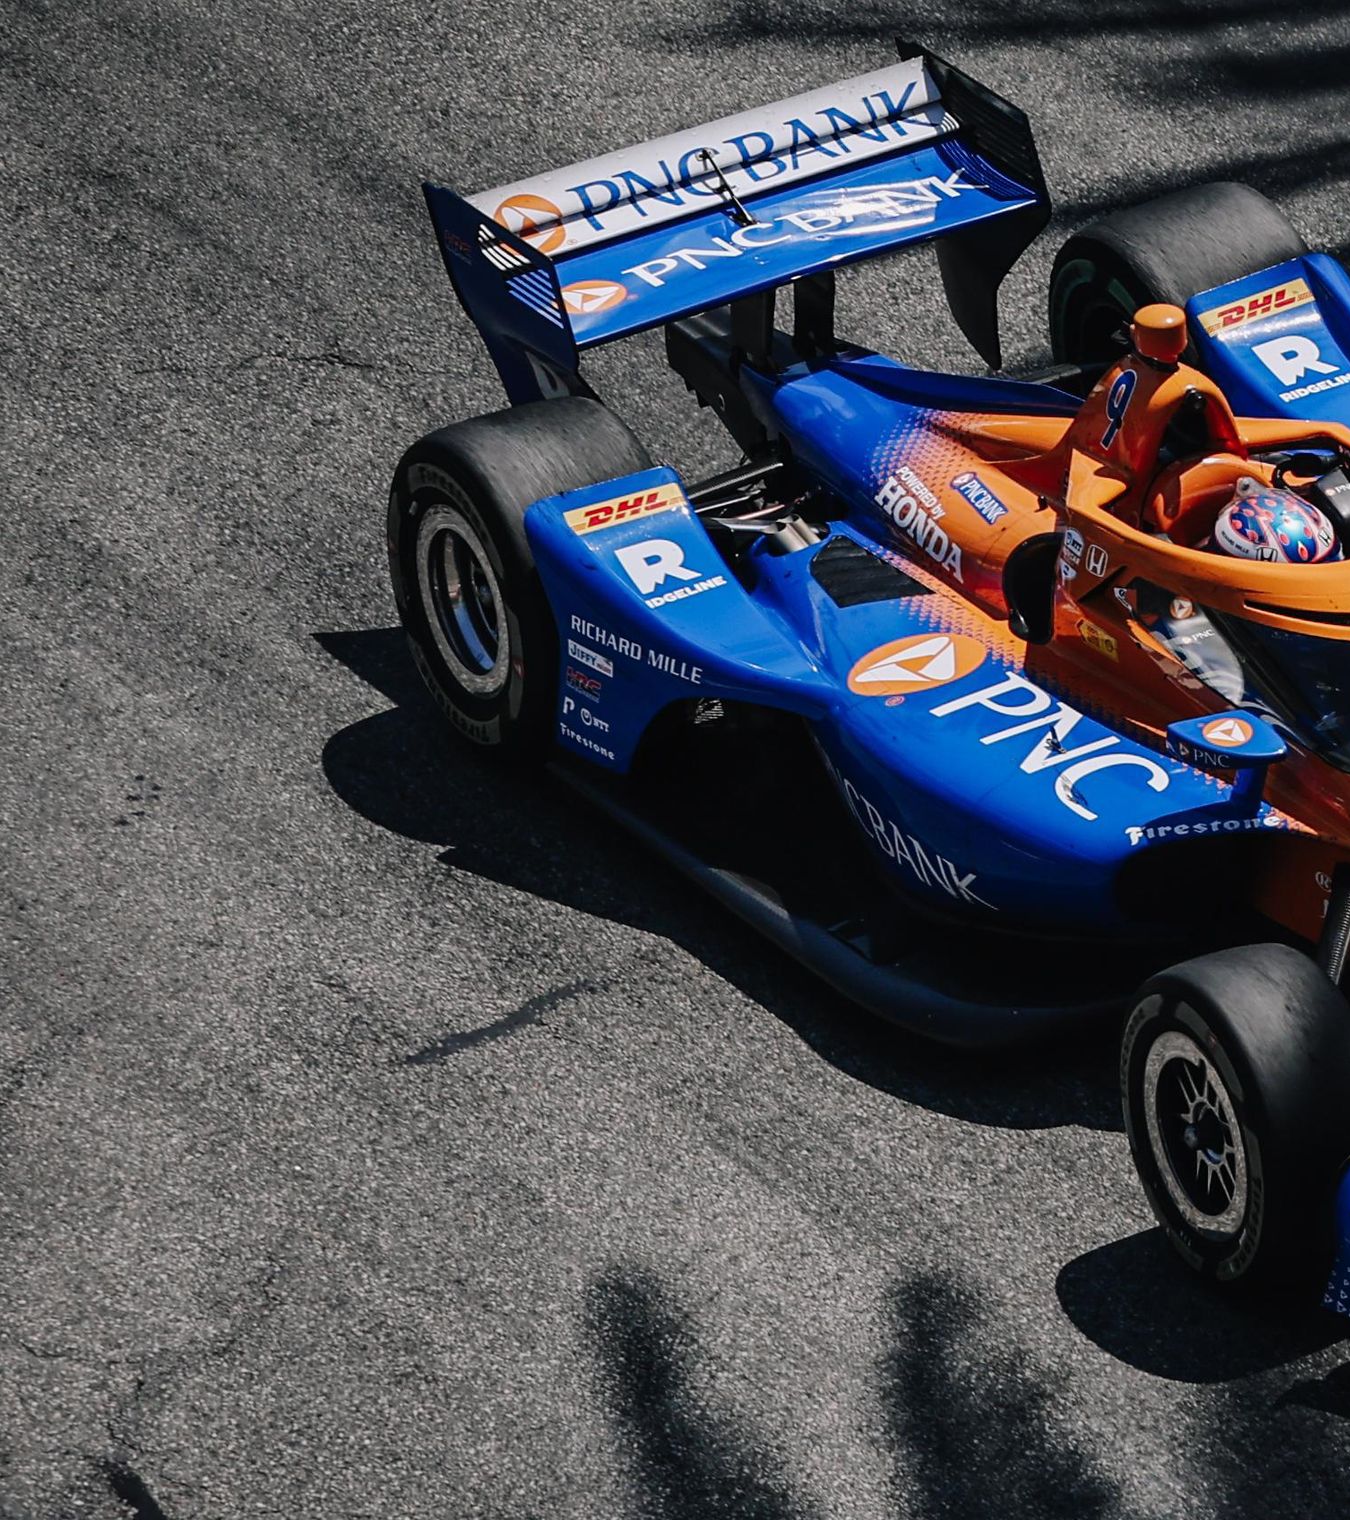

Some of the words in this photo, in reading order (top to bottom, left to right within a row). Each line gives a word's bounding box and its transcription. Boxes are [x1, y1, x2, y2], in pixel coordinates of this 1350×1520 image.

[567, 147, 737, 232] PNC
[723, 82, 938, 182] BANK
[622, 222, 792, 288] PNC
[774, 167, 990, 234] BANK
[1217, 289, 1296, 327] DHL
[1100, 368, 1138, 451] 9
[584, 492, 668, 528] DHL
[895, 465, 938, 513] POWERED
[930, 503, 946, 520] by
[974, 493, 1007, 524] BANK
[874, 475, 965, 585] HONDA
[571, 614, 643, 661] RICHARD
[648, 649, 704, 685] MILLE
[1192, 628, 1215, 643] PNC
[559, 721, 616, 761] Firestone
[929, 671, 1170, 821] PNC
[1193, 748, 1231, 768] PNC
[1124, 815, 1283, 847] Firestone
